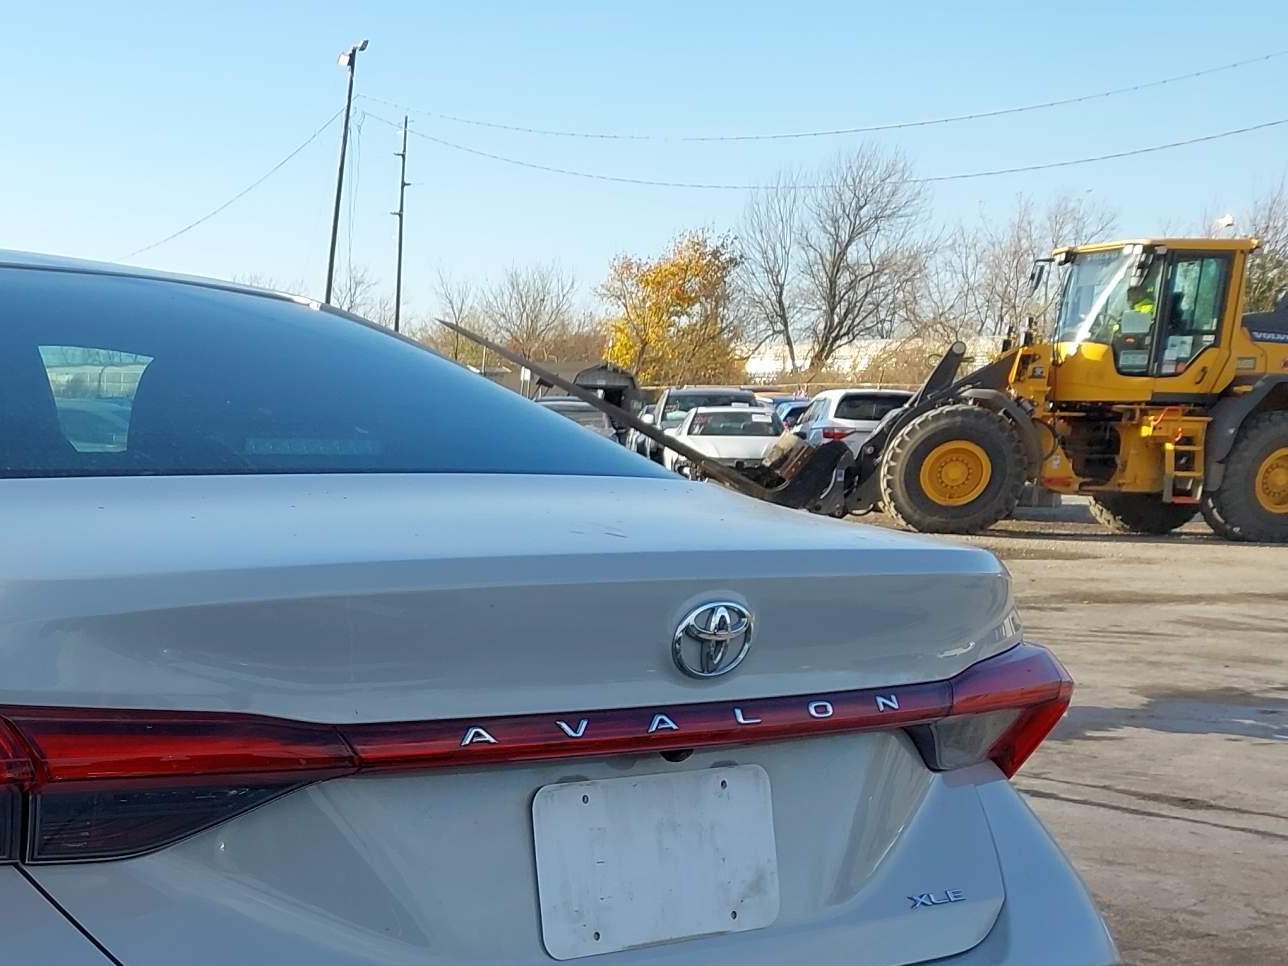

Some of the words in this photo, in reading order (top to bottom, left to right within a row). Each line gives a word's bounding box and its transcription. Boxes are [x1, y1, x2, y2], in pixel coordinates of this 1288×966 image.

[1252, 331, 1288, 341] VOLV
[460, 693, 900, 747] AVALON
[907, 888, 966, 909] XLE
